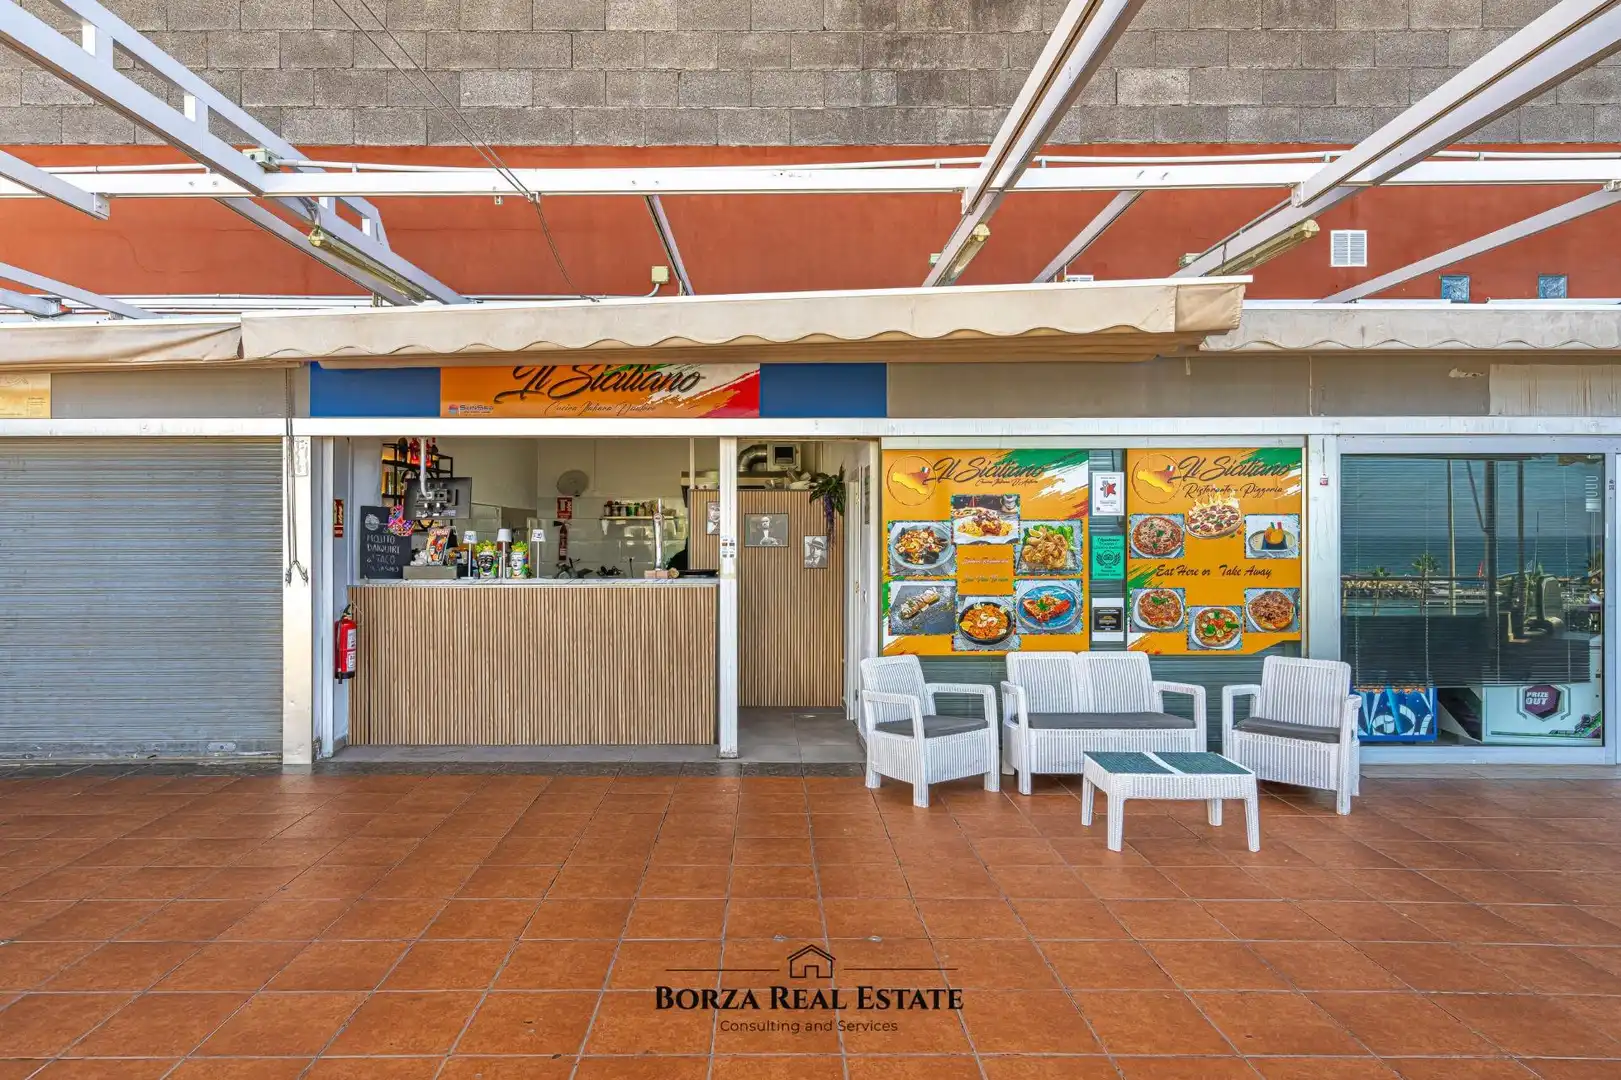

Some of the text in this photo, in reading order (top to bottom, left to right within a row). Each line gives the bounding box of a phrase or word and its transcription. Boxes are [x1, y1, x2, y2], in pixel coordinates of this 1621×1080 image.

[547, 365, 706, 400] Siciliano
[954, 457, 1045, 483] Siciliano
[1200, 456, 1292, 482] Siciliano
[1240, 482, 1284, 498] Pizzeria
[1155, 564, 1174, 577] Eat
[1175, 564, 1199, 576] Here
[1218, 564, 1241, 576] Take
[1243, 565, 1273, 579] Away
[1525, 697, 1548, 705] OUT
